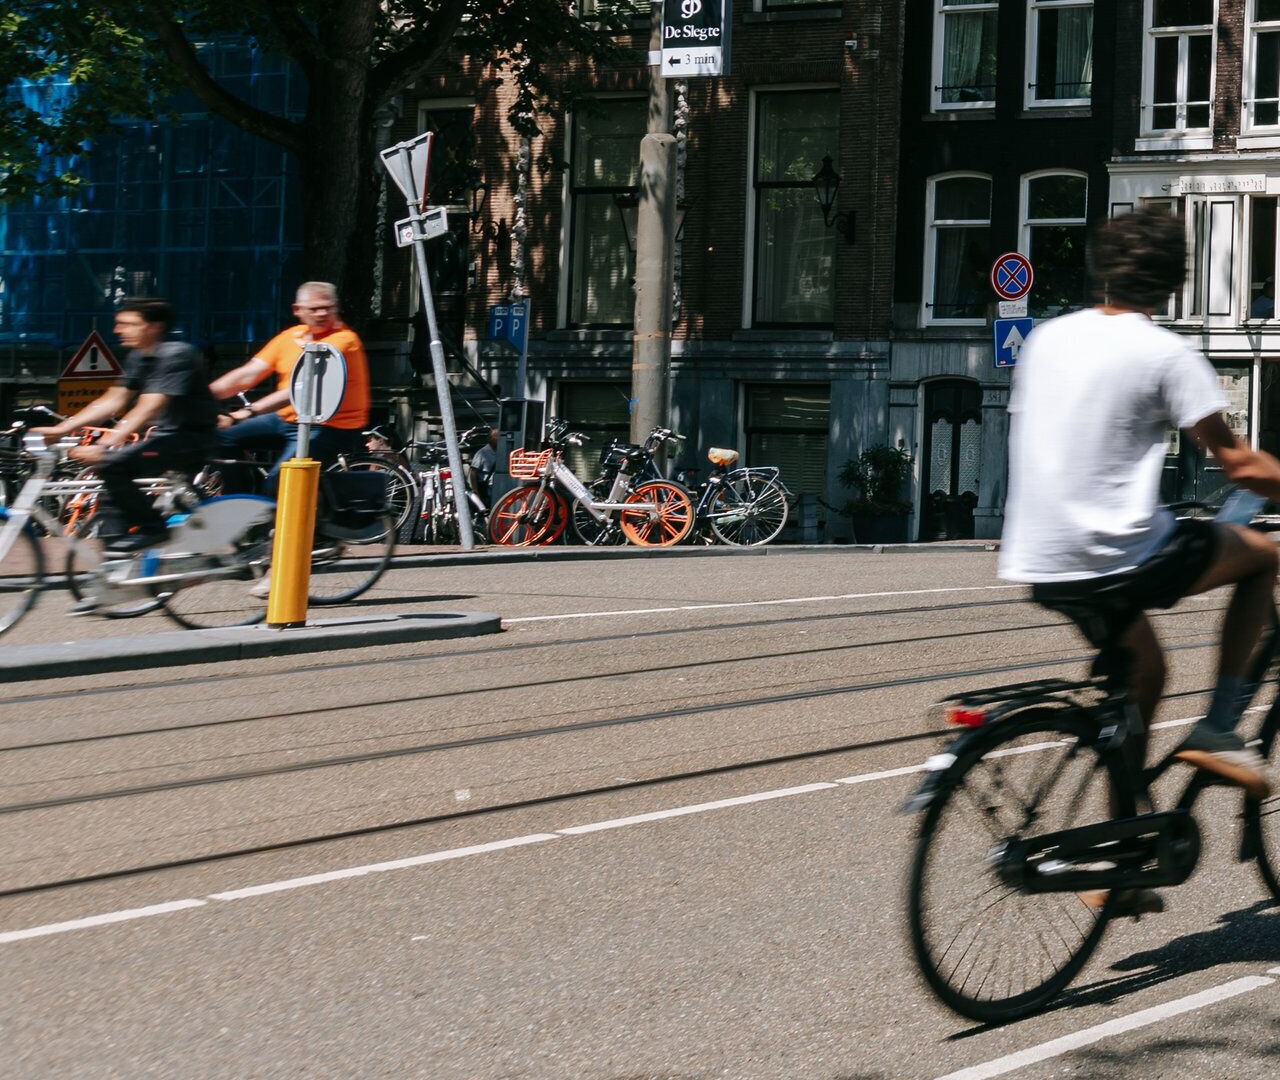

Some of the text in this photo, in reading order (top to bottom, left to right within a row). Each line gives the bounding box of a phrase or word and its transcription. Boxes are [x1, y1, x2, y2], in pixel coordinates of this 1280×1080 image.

[664, 24, 720, 41] De Slegte
[685, 53, 715, 65] 3 min
